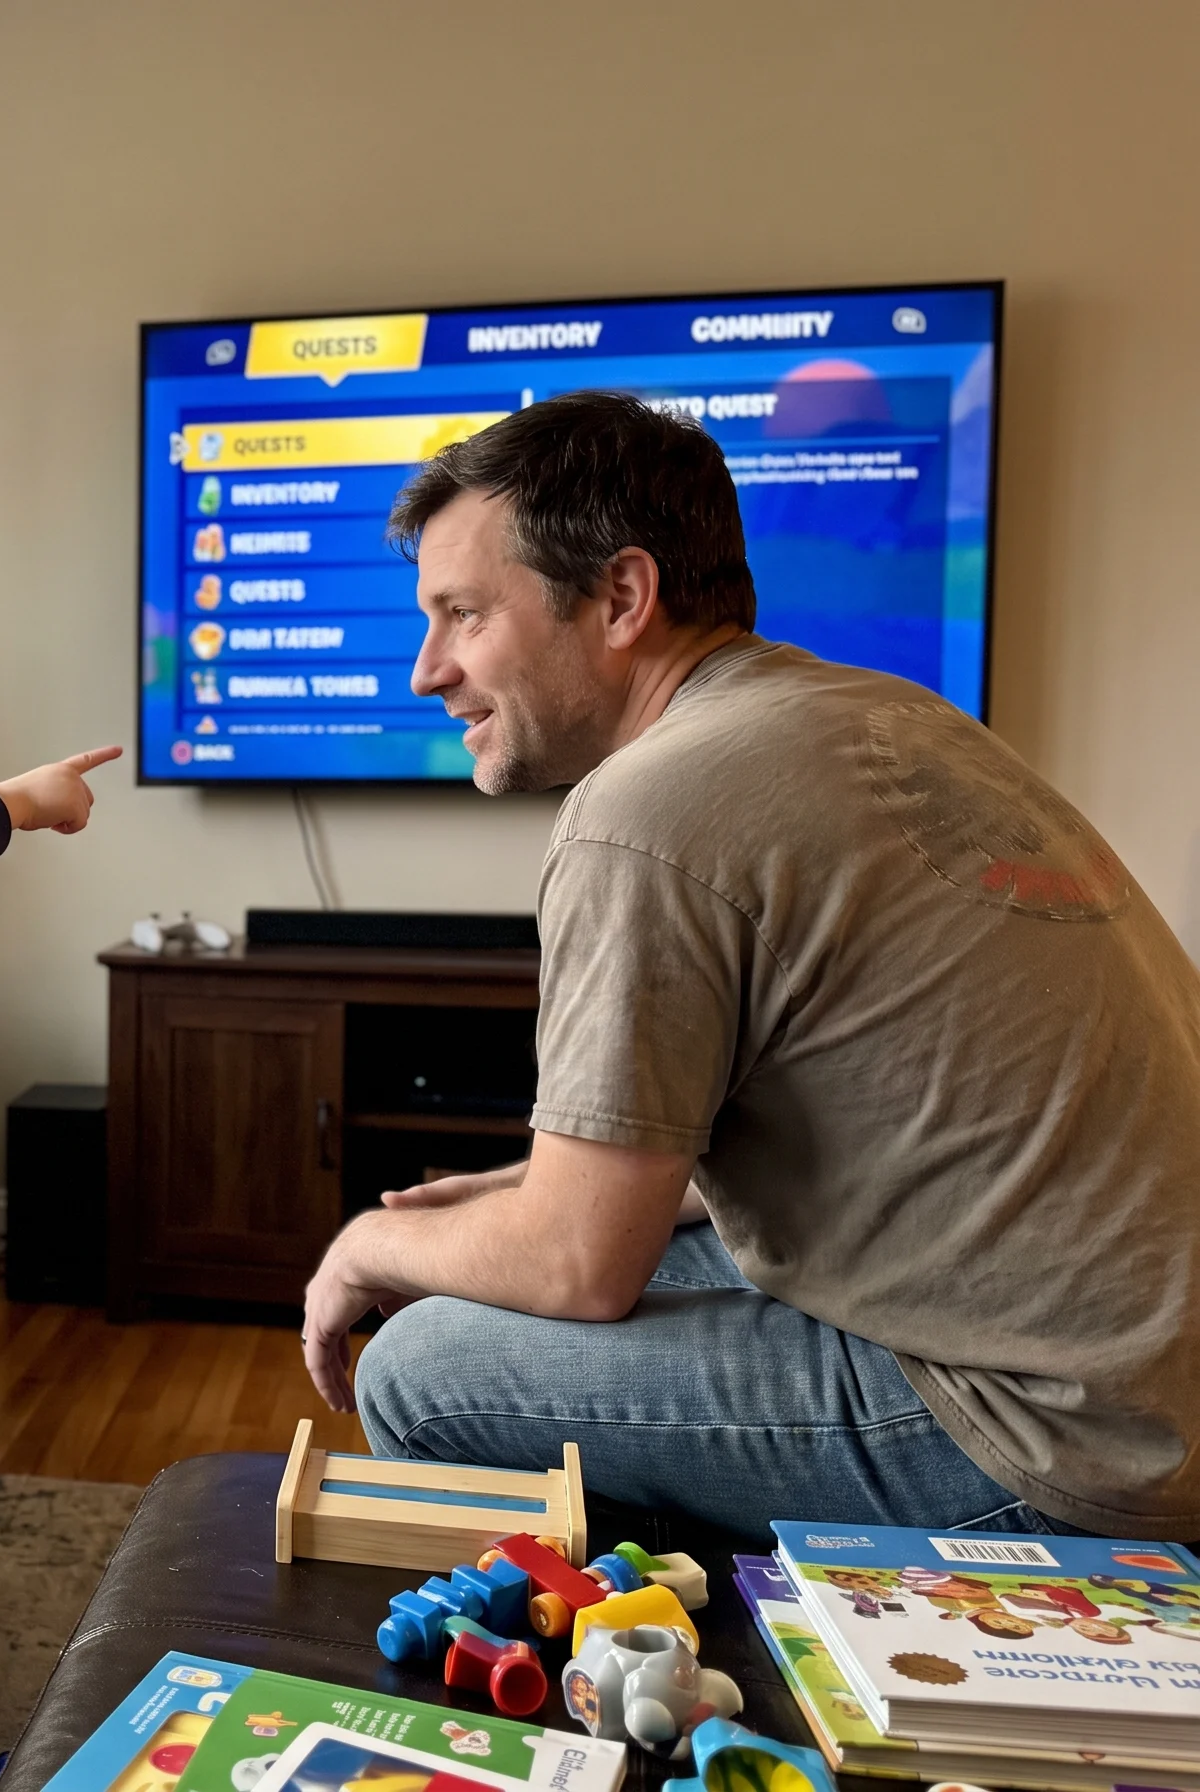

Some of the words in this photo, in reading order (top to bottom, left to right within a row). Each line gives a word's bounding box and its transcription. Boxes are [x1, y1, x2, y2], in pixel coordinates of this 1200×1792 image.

[293, 336, 378, 361] QUESTS
[468, 322, 601, 353] INVENTORY
[708, 394, 779, 418] QUEST
[234, 434, 307, 457] QUESTS
[231, 482, 339, 504] INVENTORY
